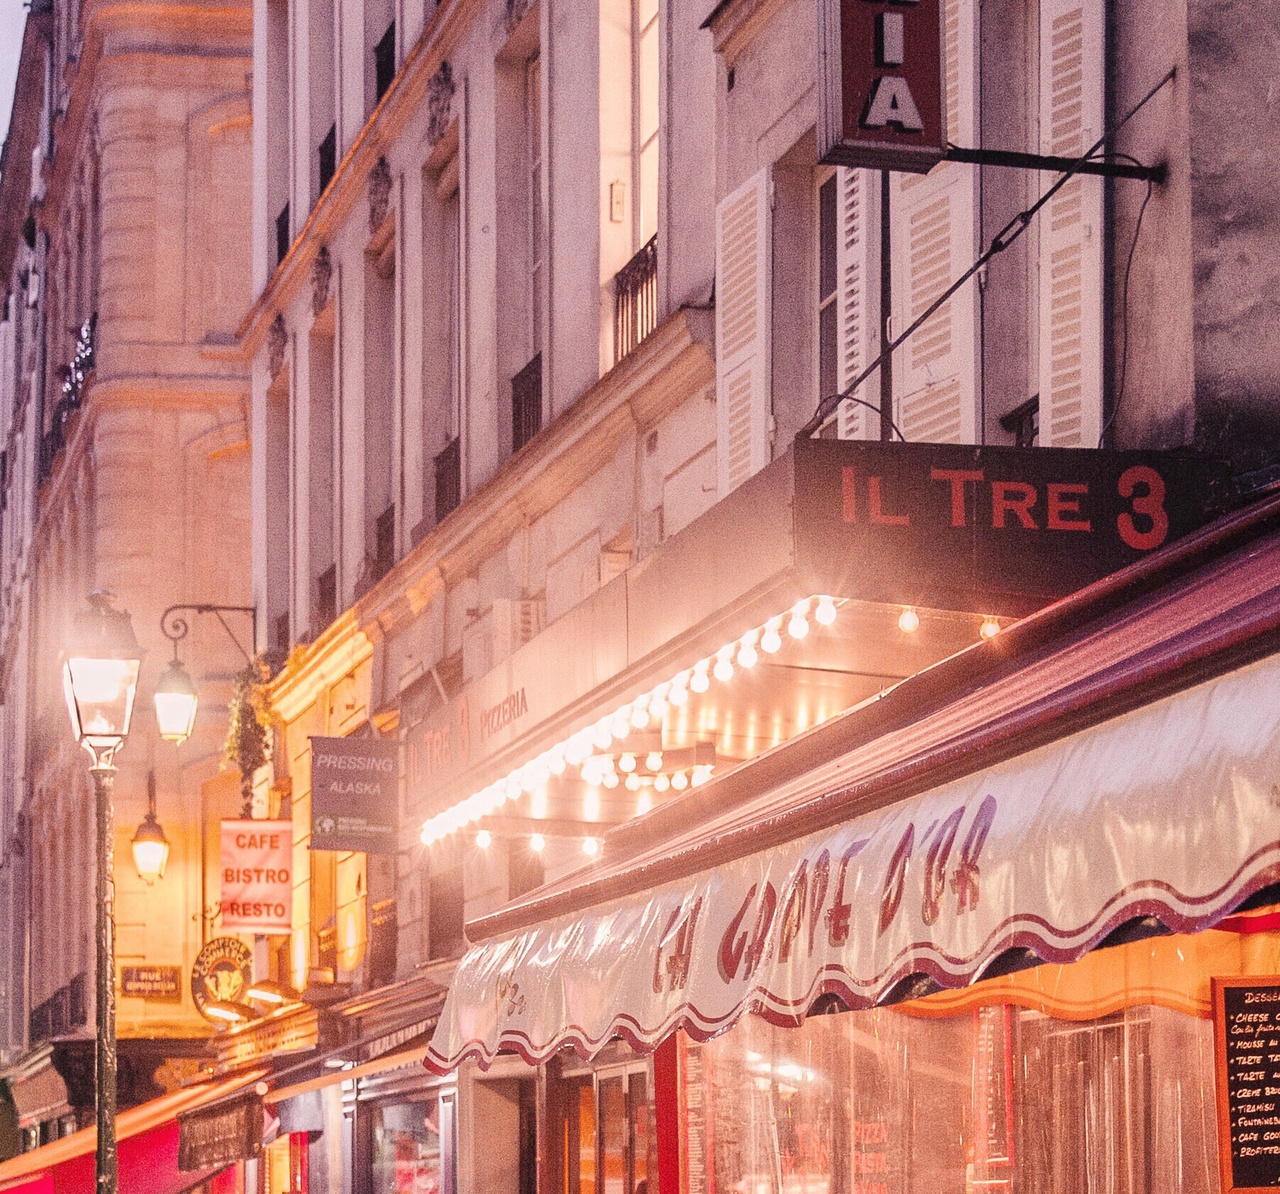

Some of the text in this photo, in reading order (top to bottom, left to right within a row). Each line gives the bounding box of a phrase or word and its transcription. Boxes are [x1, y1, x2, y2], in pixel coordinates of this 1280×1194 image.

[841, 465, 1169, 551] IL TRE 3
[480, 687, 528, 742] PIZZERIA
[317, 755, 395, 773] PRESSING
[329, 781, 381, 795] ALASKA
[235, 834, 280, 849] CAFE
[224, 868, 290, 884] BISTRO
[230, 902, 286, 918] RESTO
[1236, 1013, 1269, 1023] CHEESE
